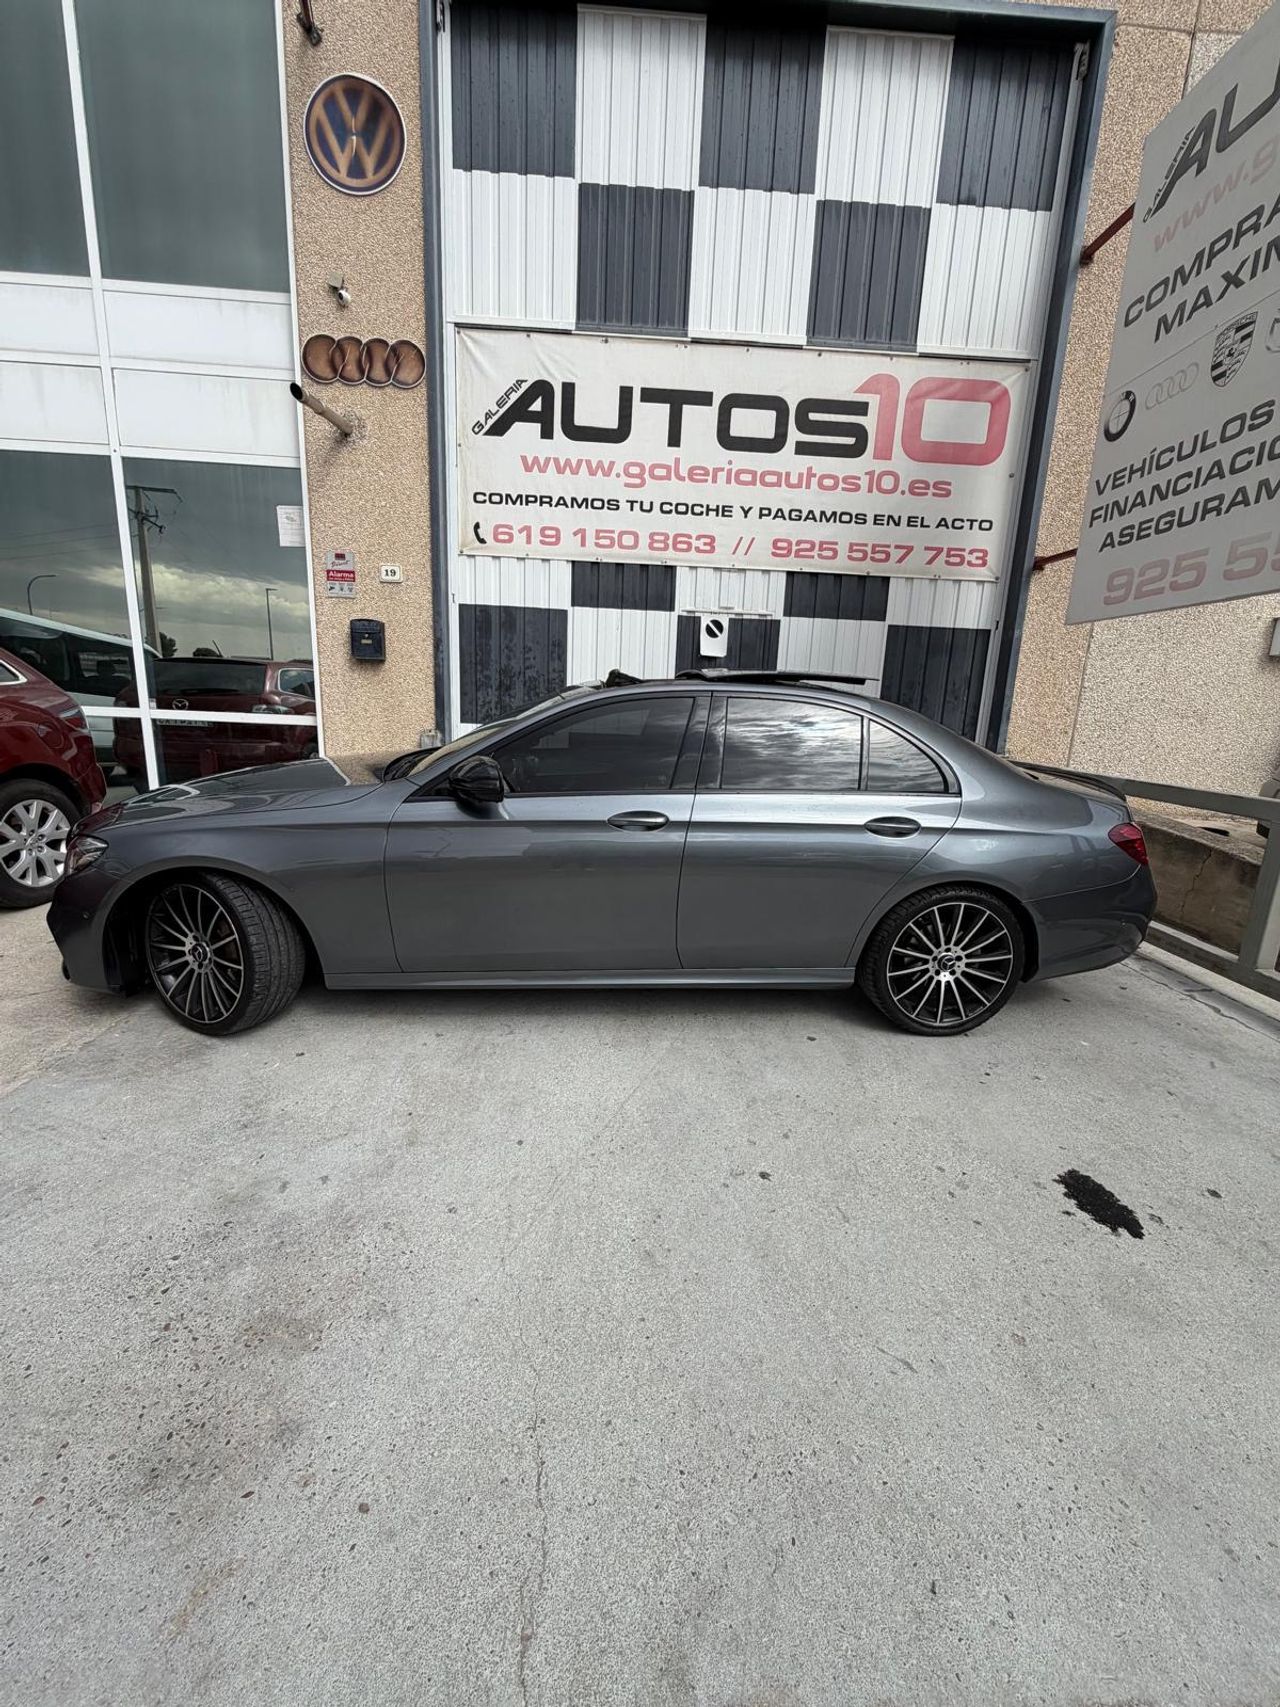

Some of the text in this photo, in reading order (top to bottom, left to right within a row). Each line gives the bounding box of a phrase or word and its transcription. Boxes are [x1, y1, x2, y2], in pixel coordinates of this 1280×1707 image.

[308, 78, 400, 188] VW
[471, 379, 528, 435] GALERIA
[482, 373, 1010, 466] AUTOS10
[1095, 399, 1276, 496] VEHÍCULOS
[520, 454, 952, 498] www.galeriaautos10.es
[473, 491, 994, 531] COMPRAMOS TU COCHE Y PAGAMOS EN EL ACTO
[385, 569, 396, 577] 19
[492, 524, 562, 547] 619
[573, 527, 640, 551] 150
[648, 532, 716, 554] 863
[771, 538, 839, 560] 925
[846, 542, 914, 565] 557
[923, 546, 989, 568] 753
[1103, 526, 1280, 606] 925 5
